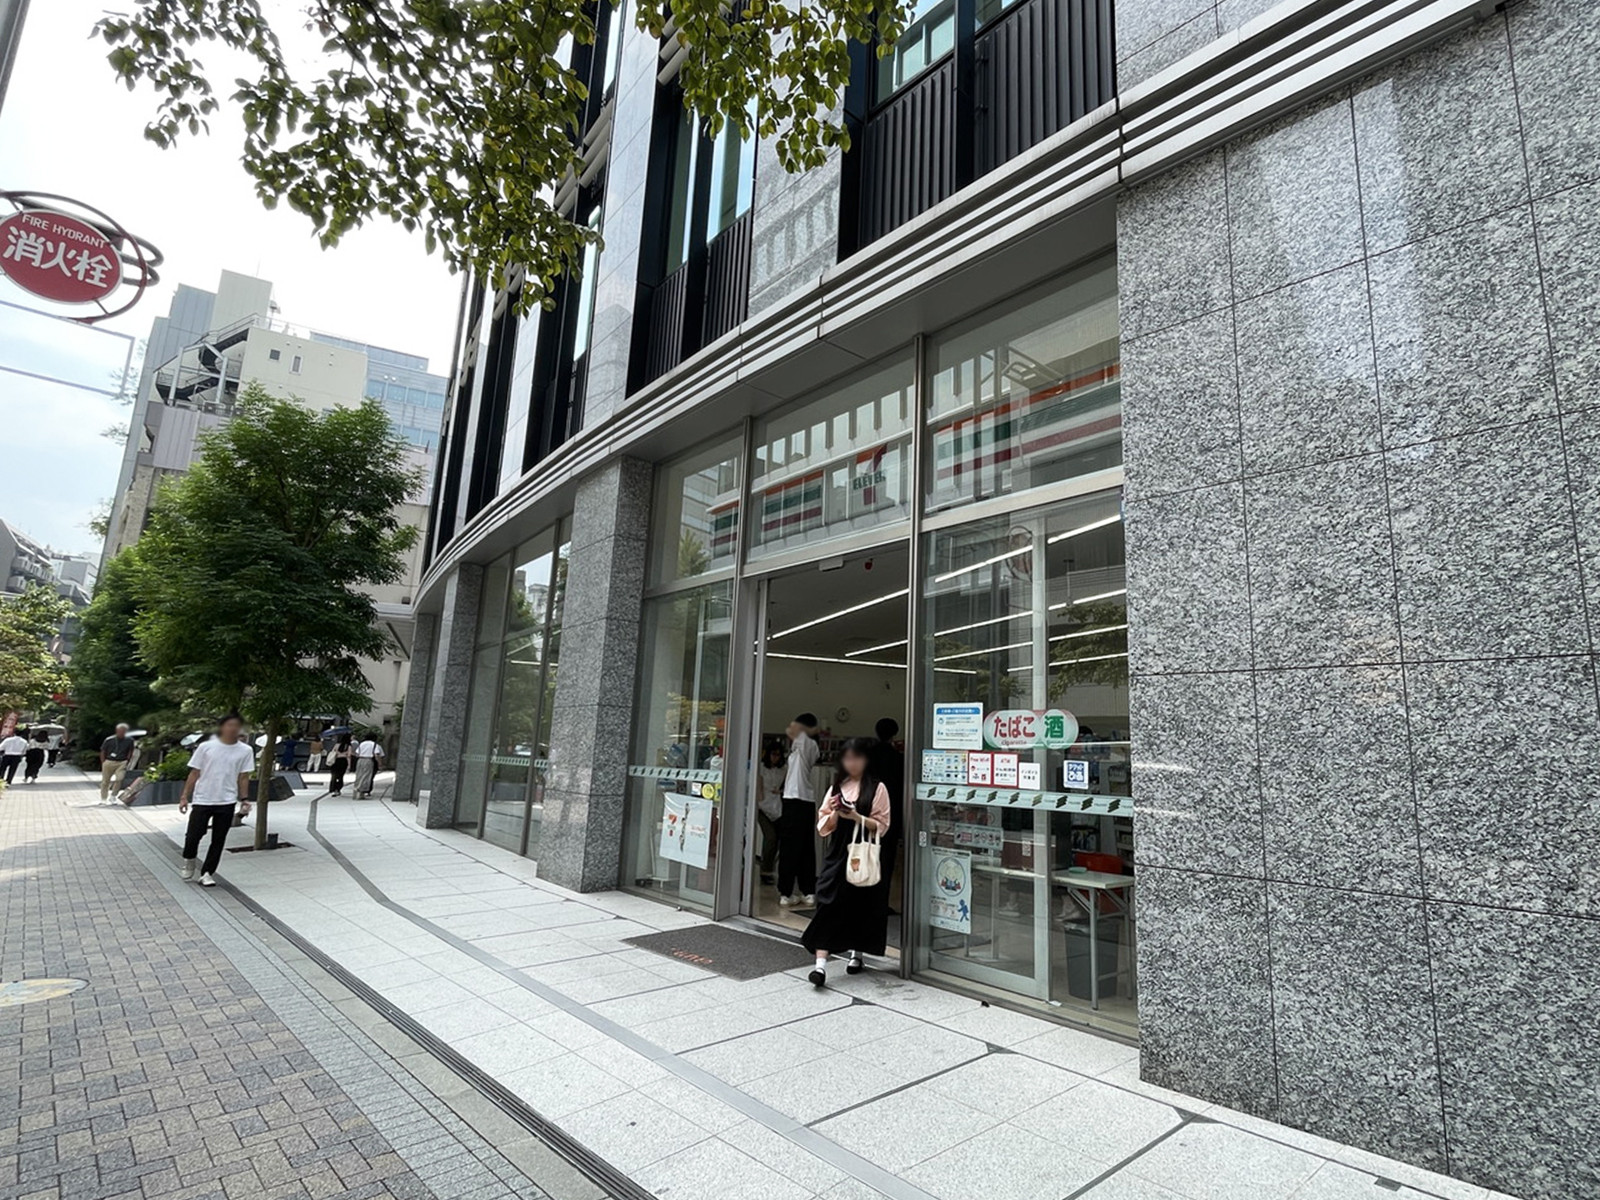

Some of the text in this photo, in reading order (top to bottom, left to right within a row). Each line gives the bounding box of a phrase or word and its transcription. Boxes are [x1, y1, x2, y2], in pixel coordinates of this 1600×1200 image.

[22, 215, 106, 248] FIRE HYDRANT
[3, 227, 113, 287] 消火栓
[994, 716, 1035, 738] たばこ
[1044, 716, 1064, 738] 酒
